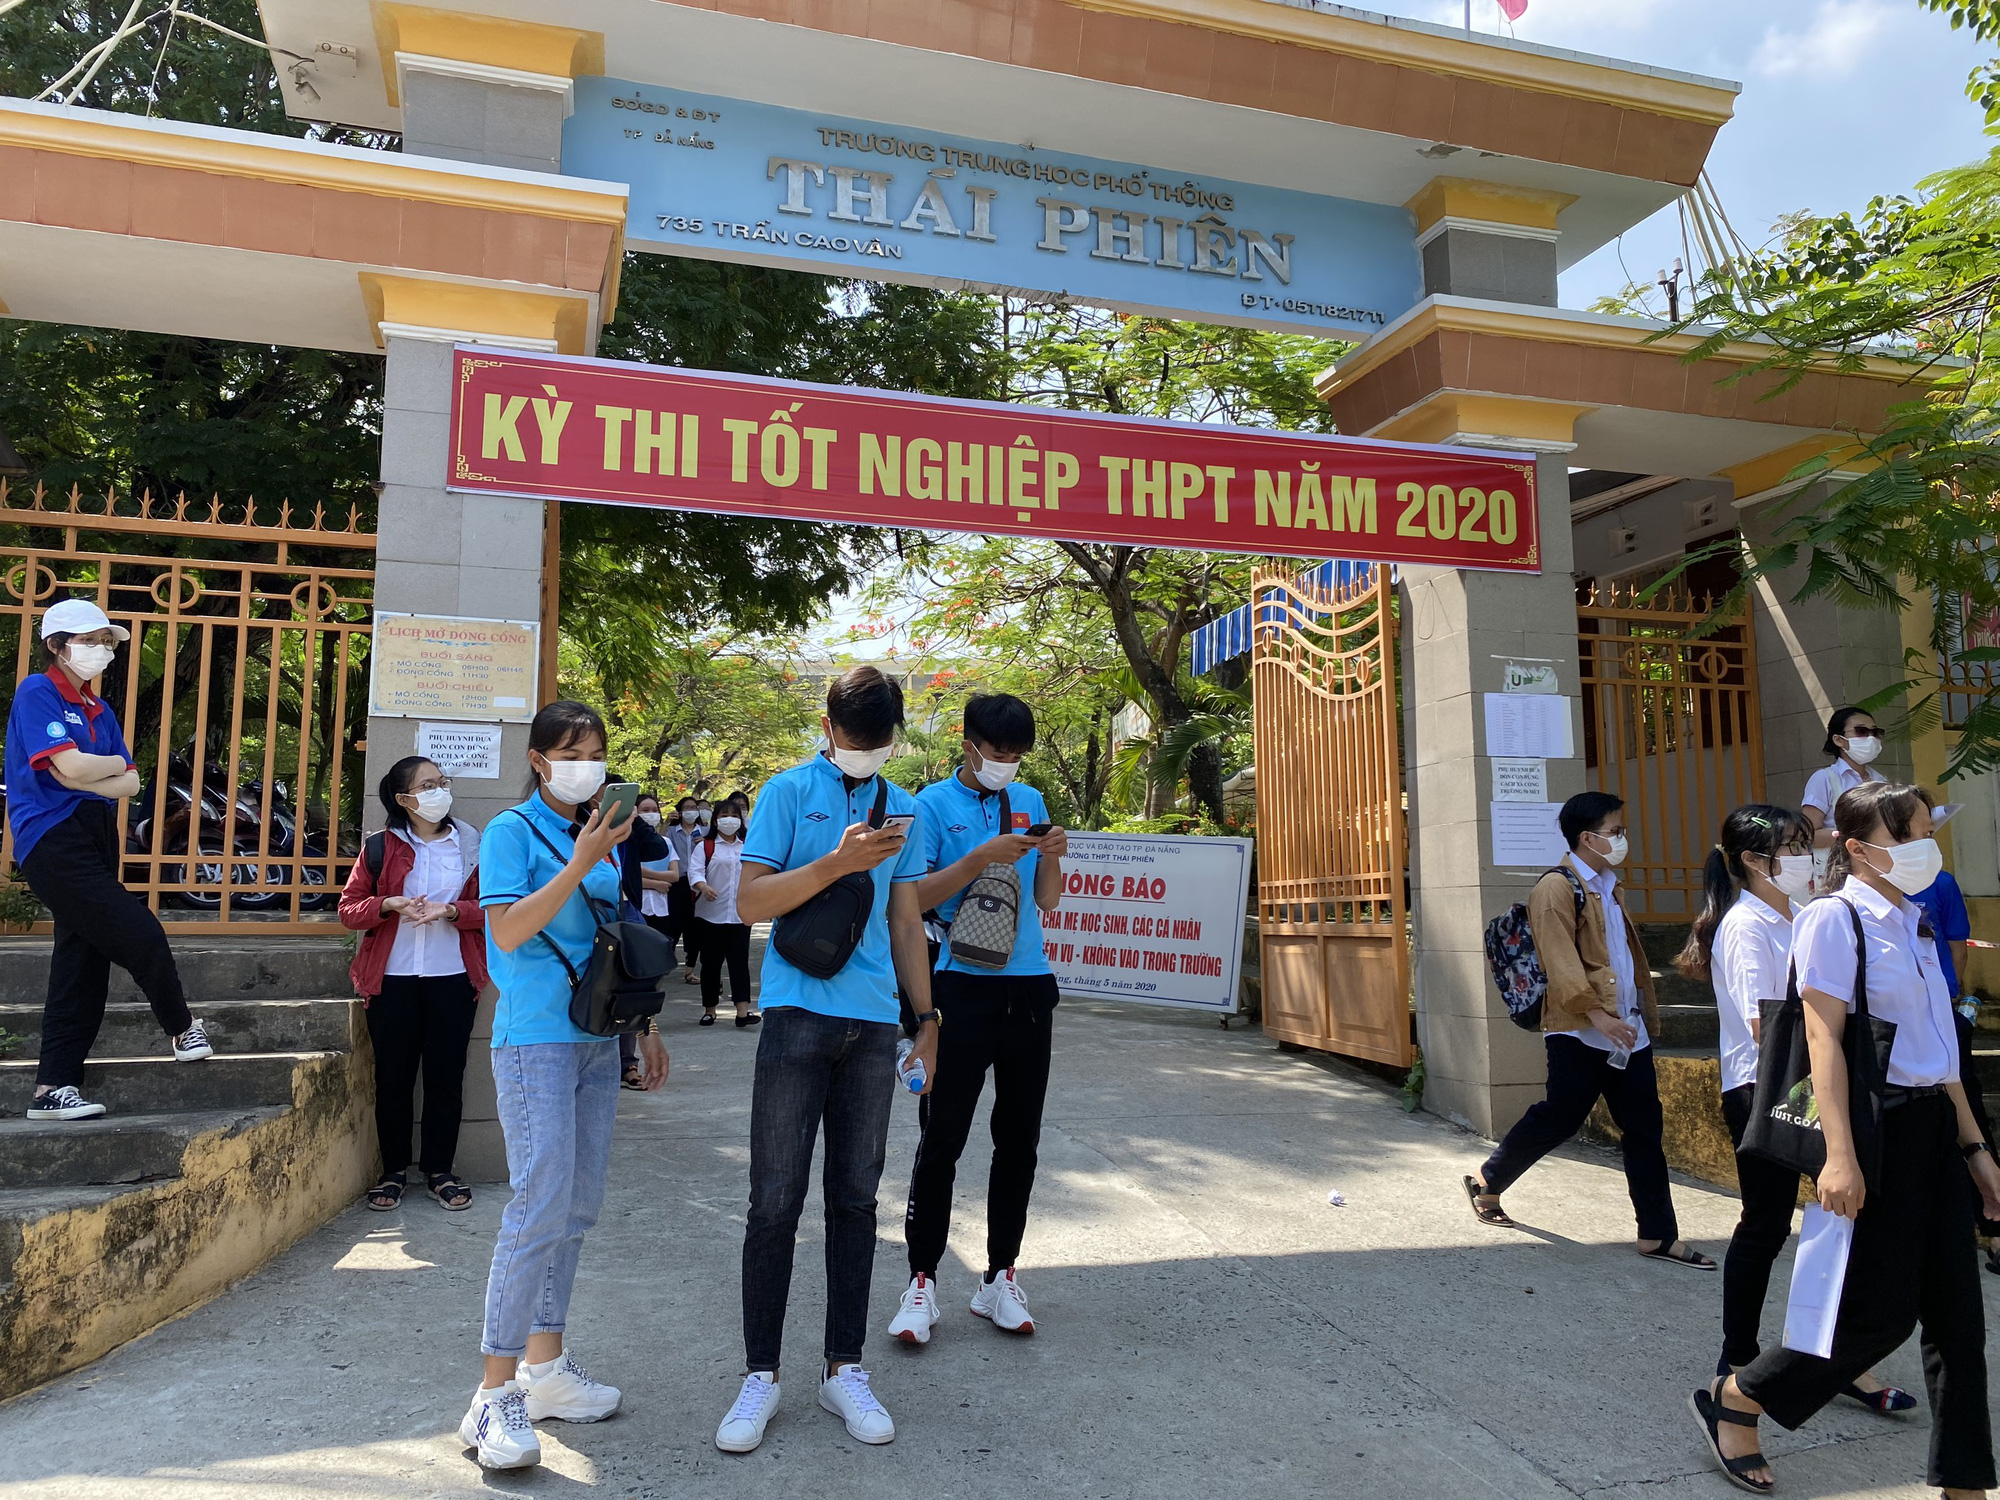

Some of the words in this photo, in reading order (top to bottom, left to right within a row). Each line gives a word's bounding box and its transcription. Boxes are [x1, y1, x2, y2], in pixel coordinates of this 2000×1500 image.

[675, 107, 689, 119] &
[940, 146, 1031, 180] TRUNG
[1093, 171, 1149, 197] PHỔ
[1149, 181, 1235, 212] THÔNG
[766, 156, 998, 243] THÁI
[1035, 197, 1296, 286] PHIÊN
[656, 214, 705, 233] 735
[793, 231, 851, 252] CAO
[853, 237, 903, 259] VÂN
[481, 384, 573, 466] KỲ
[595, 404, 700, 479] THI
[723, 402, 838, 491] TỐT
[858, 432, 1081, 523] NGHIỆP
[1099, 455, 1236, 524] THPT
[1254, 460, 1378, 535] NĂM
[1395, 482, 1518, 546] 2020
[425, 626, 446, 639] MỞ
[490, 630, 527, 644] CỔNG
[420, 650, 452, 660] BUỔI
[456, 652, 493, 662] SÁNG
[428, 734, 444, 742] PHỤ
[1068, 842, 1085, 850] DỤC
[1112, 853, 1130, 861] THÁI
[1131, 854, 1155, 863] PHIÊN
[1121, 873, 1167, 900] BÁO
[1042, 910, 1062, 930] CHA
[1064, 911, 1079, 934] MẸ
[1080, 912, 1102, 935] HỌC
[1103, 914, 1130, 937] SINH,
[1132, 914, 1154, 938] CÁC
[1156, 915, 1170, 938] CÁ
[1172, 917, 1202, 941] NHÂN
[1061, 943, 1075, 967] VỤ
[1082, 943, 1117, 967] KHÔNG
[1119, 945, 1140, 970] VÀO
[1142, 950, 1177, 973] TRONG
[1179, 952, 1222, 978] TRƯỜNG
[1074, 975, 1101, 988] tháng
[1103, 978, 1110, 987] 5
[1111, 979, 1133, 989] năm
[1133, 981, 1157, 992] 2020
[1794, 1116, 1811, 1127] GO
